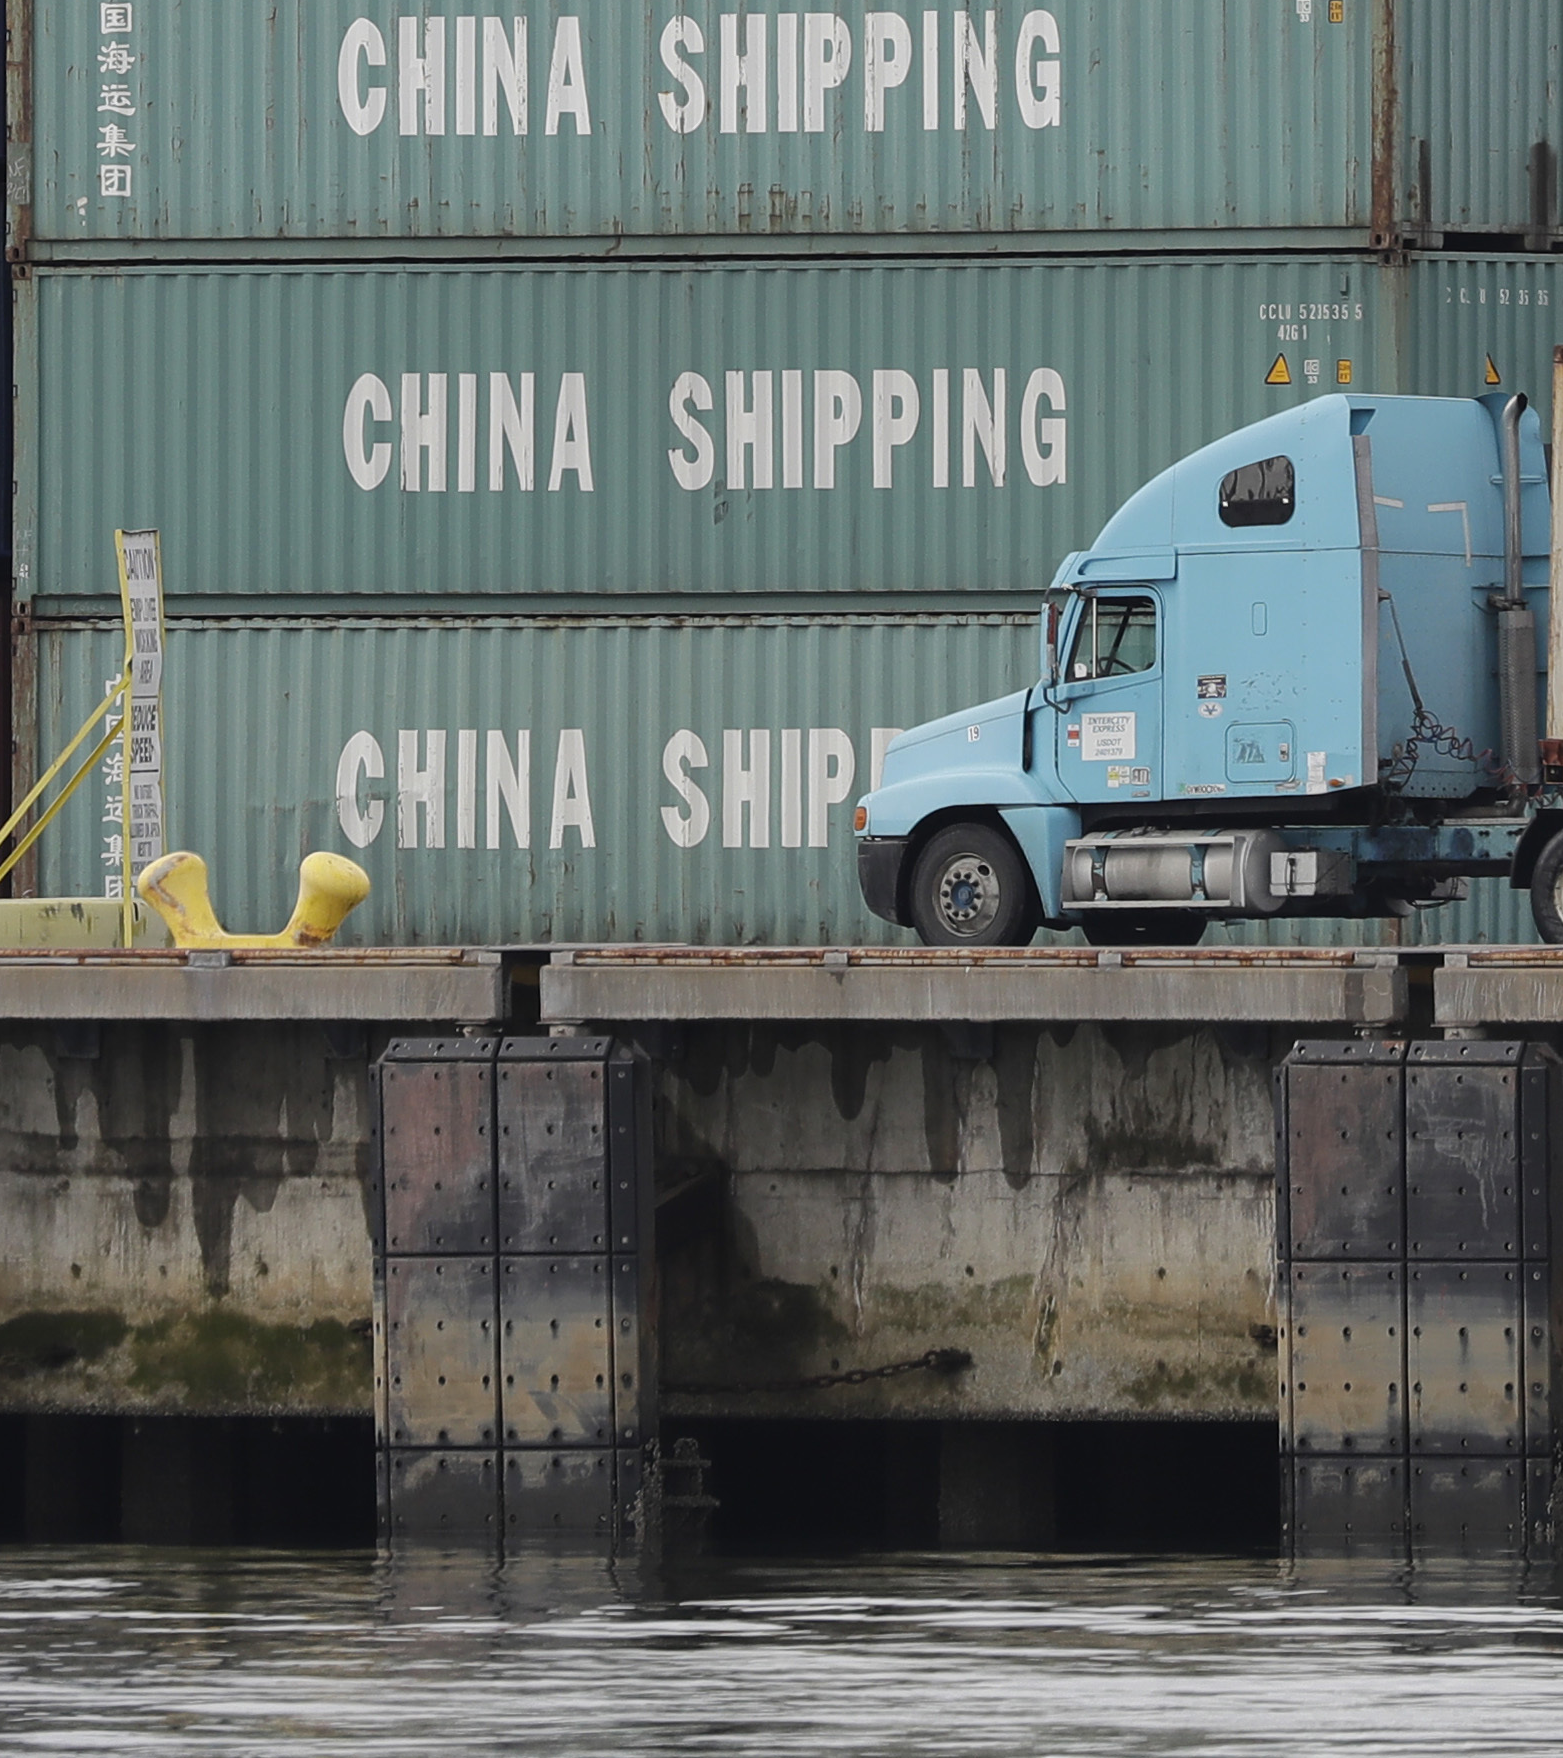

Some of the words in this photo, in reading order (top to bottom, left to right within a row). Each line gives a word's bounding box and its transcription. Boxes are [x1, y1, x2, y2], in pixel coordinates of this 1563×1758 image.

[338, 15, 592, 137] CHINA
[658, 10, 1061, 134] SHIPPING
[343, 372, 594, 492] CHINA
[668, 368, 1067, 491] SHIPPING
[124, 548, 155, 580] CAUTION
[1088, 716, 1131, 725] INTERCITY
[1092, 725, 1126, 733] EXPRESS
[969, 727, 979, 741] 19
[1096, 738, 1122, 746] USDOT
[336, 728, 596, 849] CHINA
[660, 727, 906, 849] SHIP
